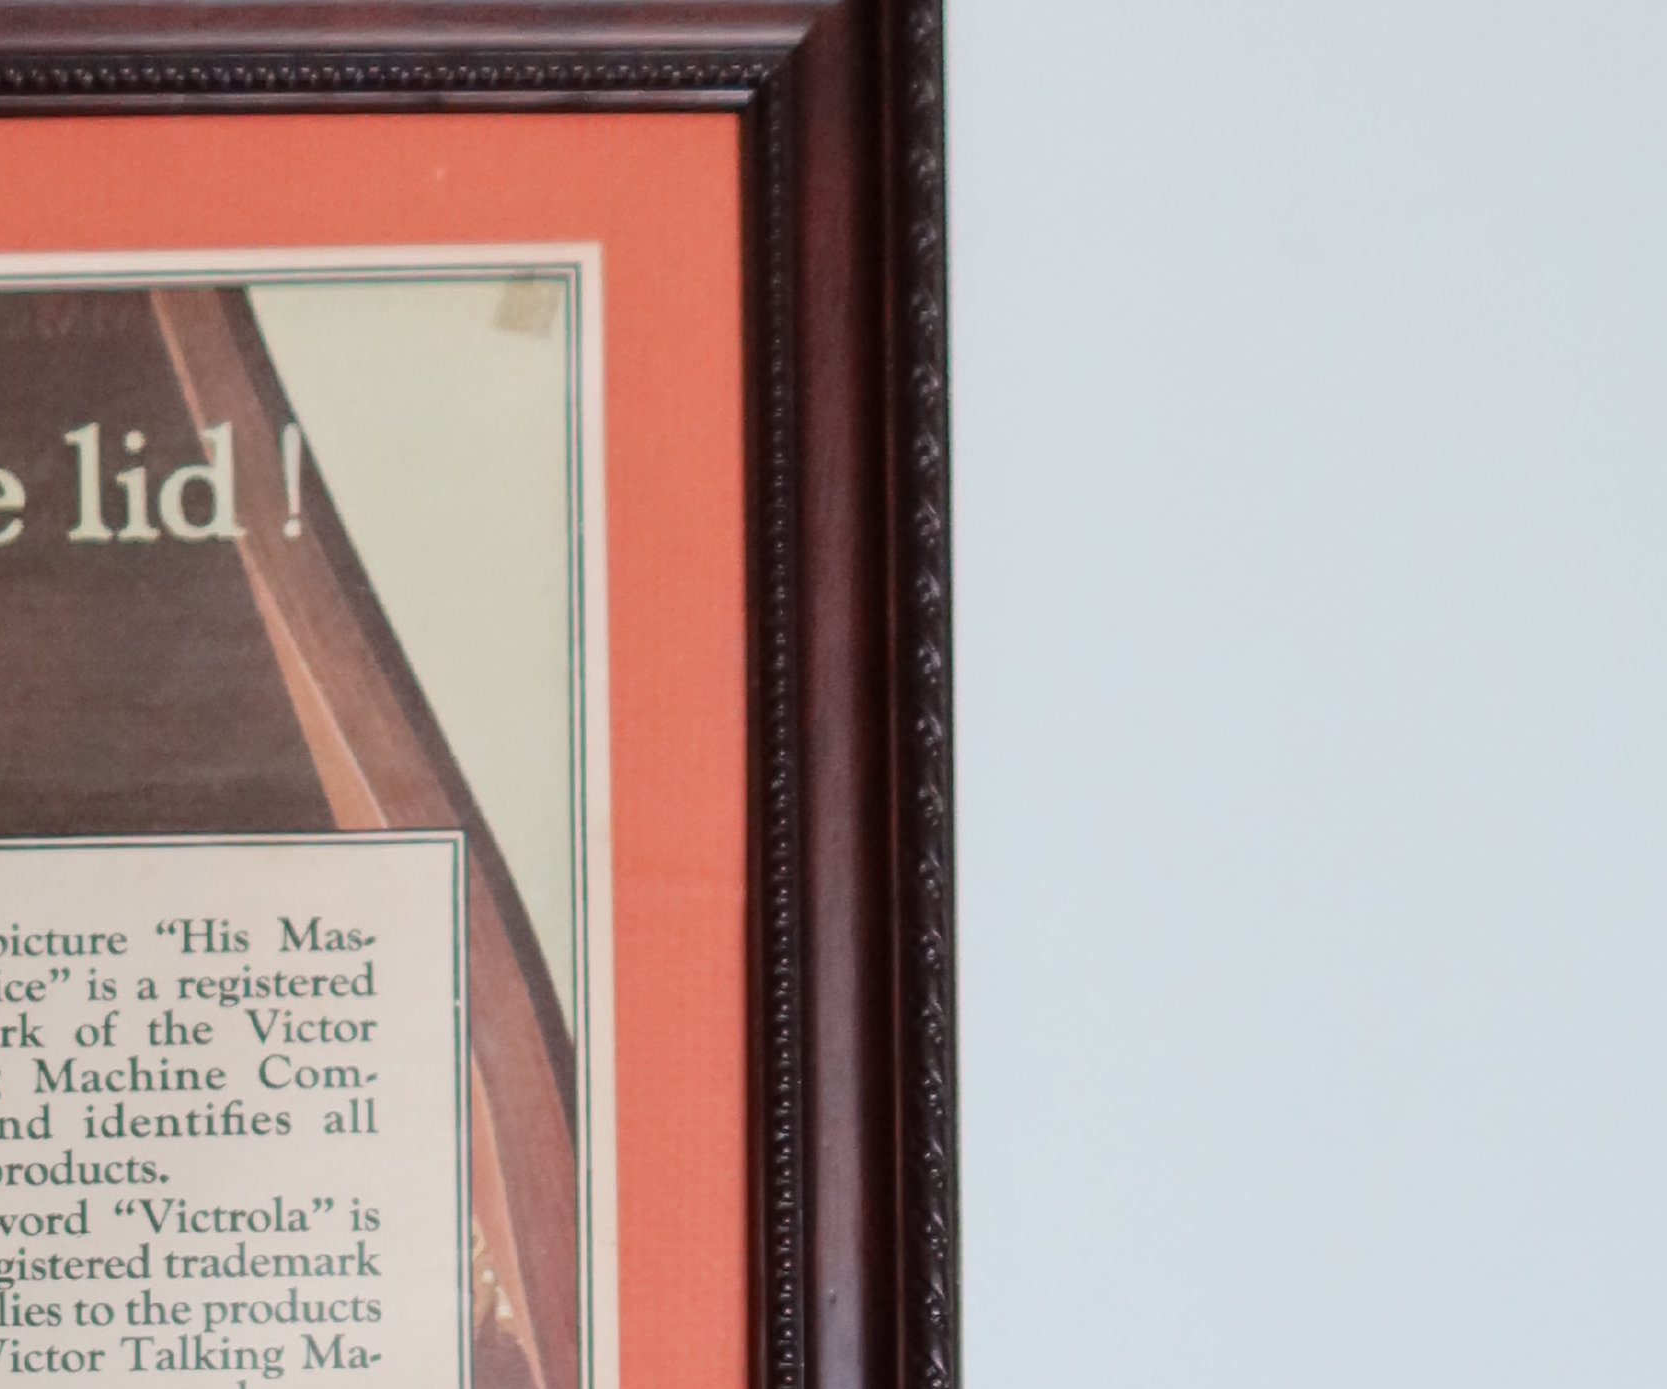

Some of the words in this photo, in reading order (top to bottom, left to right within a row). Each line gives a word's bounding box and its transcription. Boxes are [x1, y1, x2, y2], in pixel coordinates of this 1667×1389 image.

[155, 918, 250, 954] “His
[277, 916, 376, 953] Mas-
[87, 967, 118, 1002] is
[136, 977, 159, 1001] a
[176, 960, 377, 1008] registered
[74, 1009, 120, 1048] of
[146, 1008, 214, 1047] the
[244, 1008, 378, 1045] Victor
[31, 1054, 226, 1094] Machine
[258, 1053, 378, 1090] Com-
[83, 1099, 292, 1139] identifies
[323, 1097, 379, 1135] all
[113, 1195, 335, 1234] “Victrola”
[350, 1197, 381, 1232] is
[163, 1240, 382, 1280] trademark
[73, 1299, 115, 1327] to
[125, 1288, 192, 1327] the
[202, 1287, 382, 1334] products
[120, 1333, 285, 1380] Talking
[300, 1333, 382, 1370] Ma-
